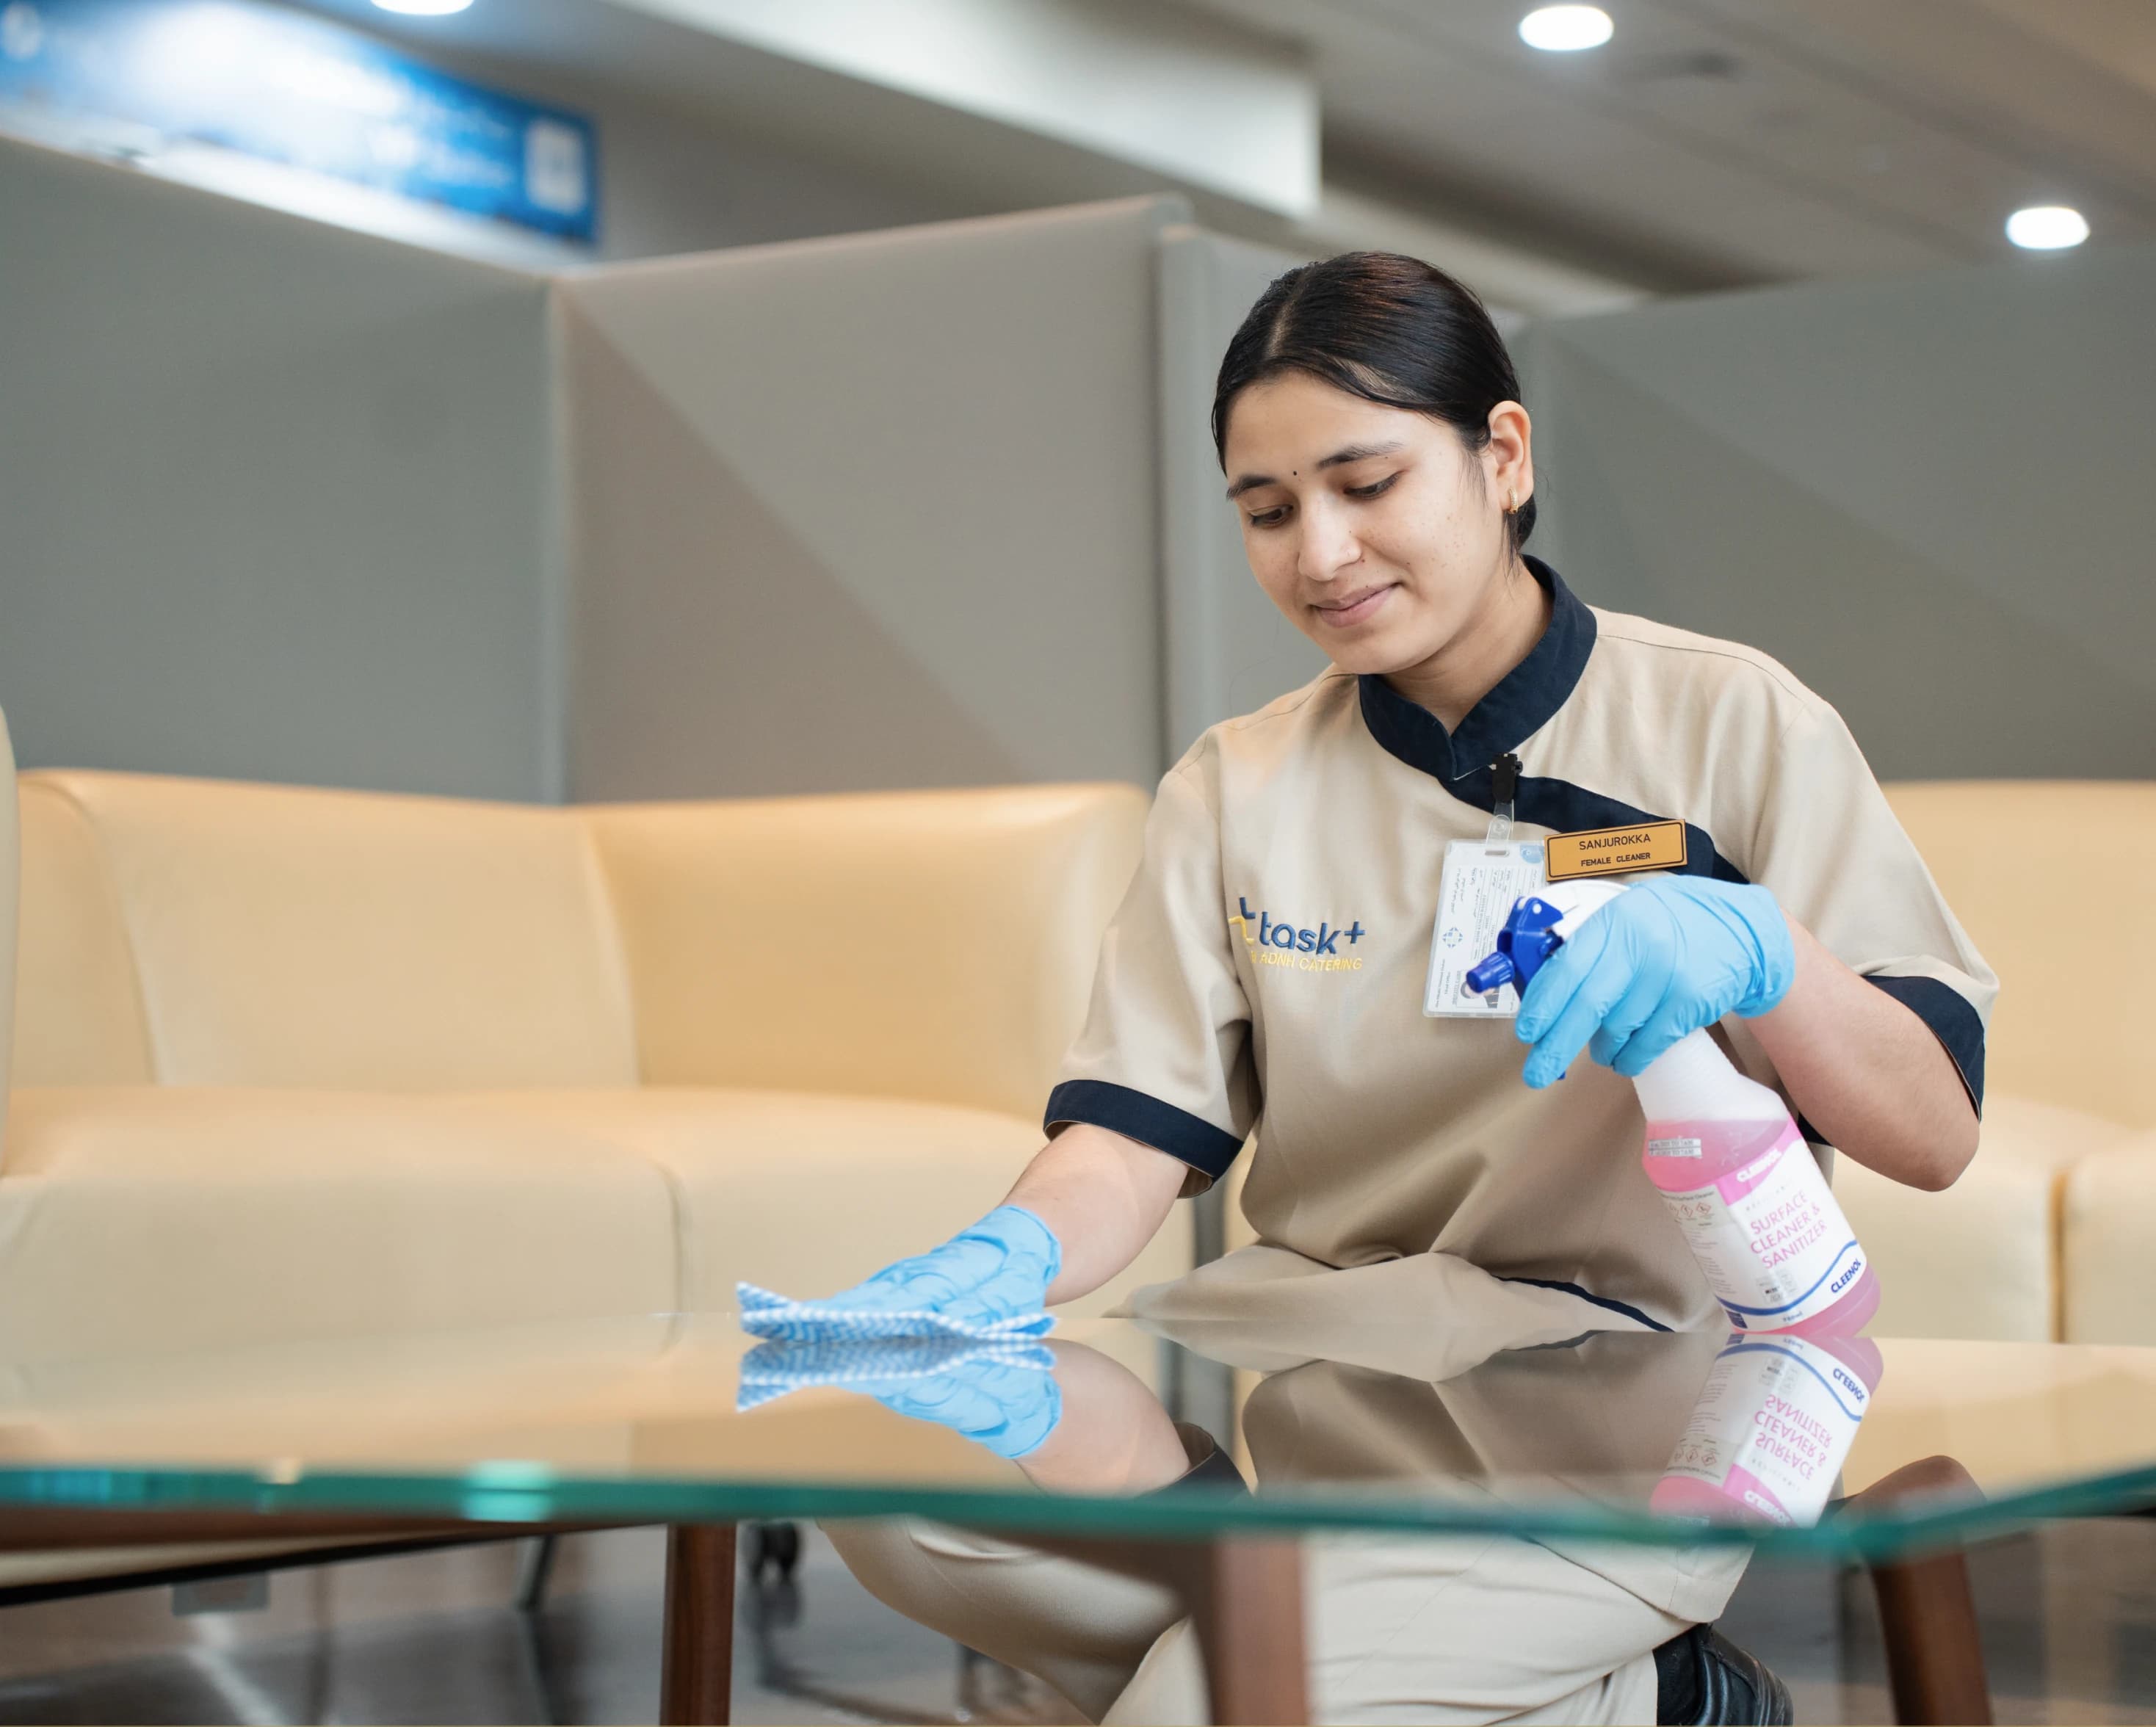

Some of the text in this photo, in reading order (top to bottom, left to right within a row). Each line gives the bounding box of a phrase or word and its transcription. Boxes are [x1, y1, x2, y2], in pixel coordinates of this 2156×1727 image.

[1579, 833, 1651, 850] SANJUROKKA
[1581, 852, 1651, 866] FEMALE CLEANER
[1259, 953, 1295, 968] ADNH
[1299, 957, 1363, 971] CATERING
[1751, 1189, 1807, 1234] SURFACE
[1751, 1211, 1811, 1253] CLEANER
[1762, 1220, 1827, 1269] SANITIZER
